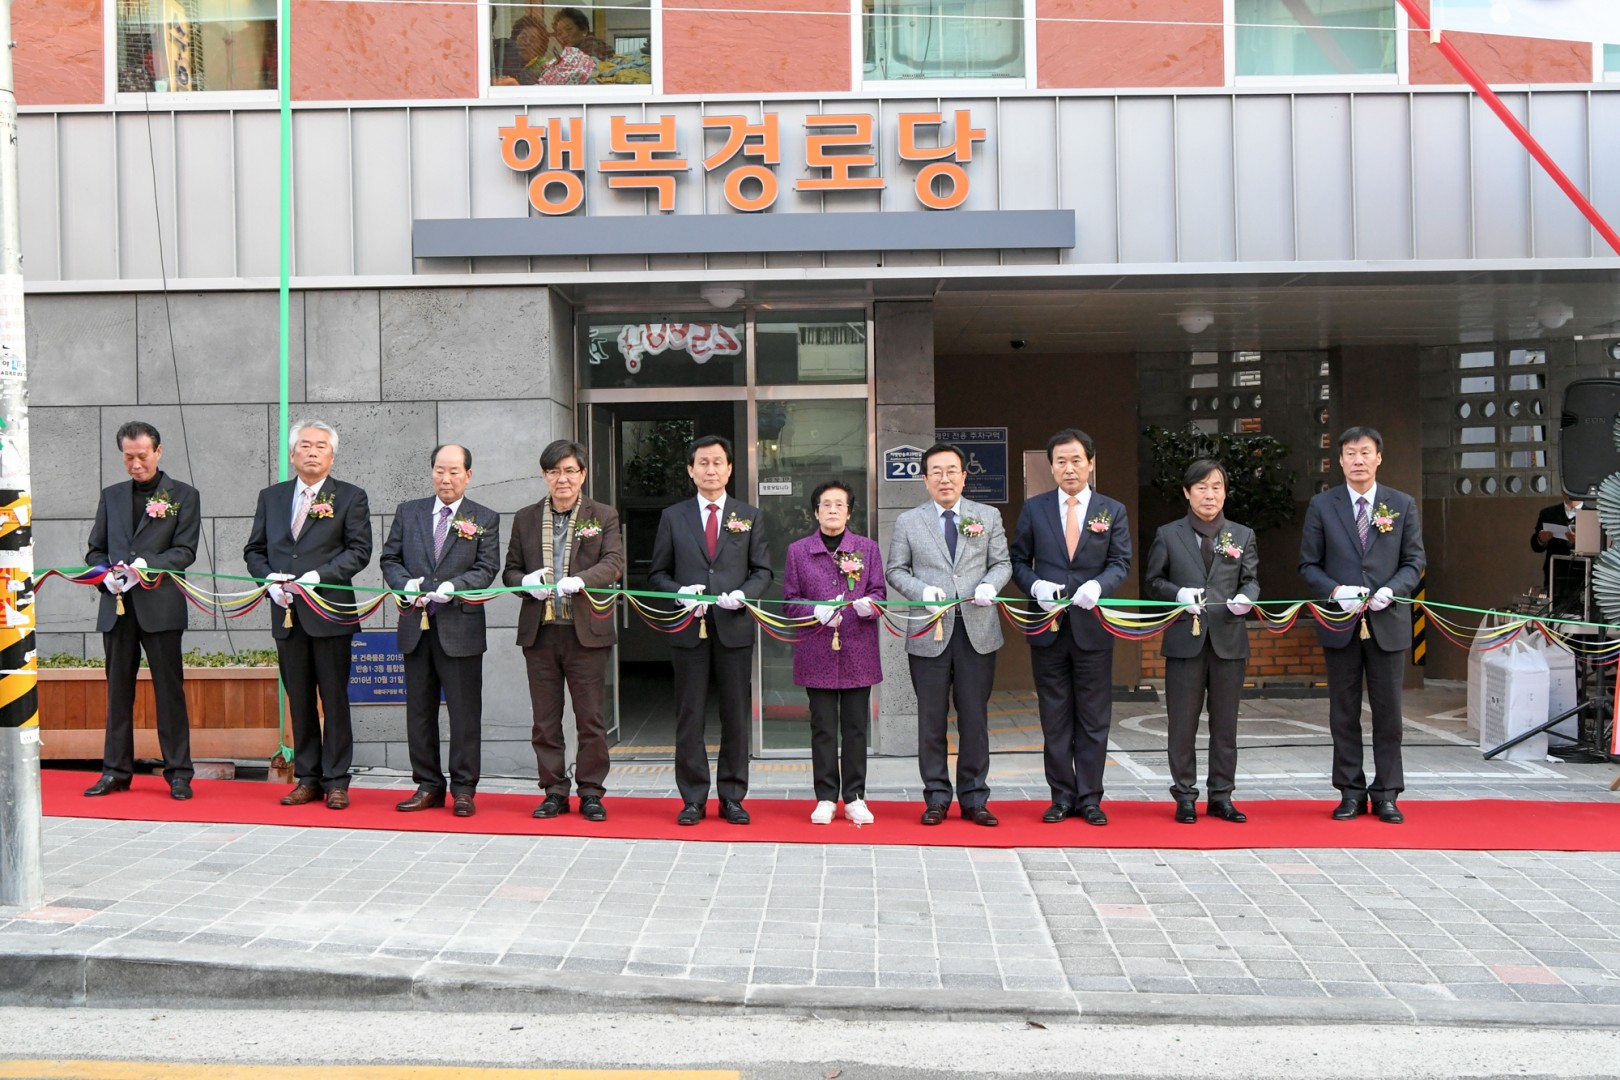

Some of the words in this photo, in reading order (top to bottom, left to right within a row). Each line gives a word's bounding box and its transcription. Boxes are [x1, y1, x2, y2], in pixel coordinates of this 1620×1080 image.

[498, 109, 986, 216] 행복경로당
[935, 431, 950, 440] 애인
[970, 431, 1000, 440] 주차구역
[892, 462, 921, 476] 20
[350, 676, 372, 684] 2016년
[374, 676, 388, 684] 10월
